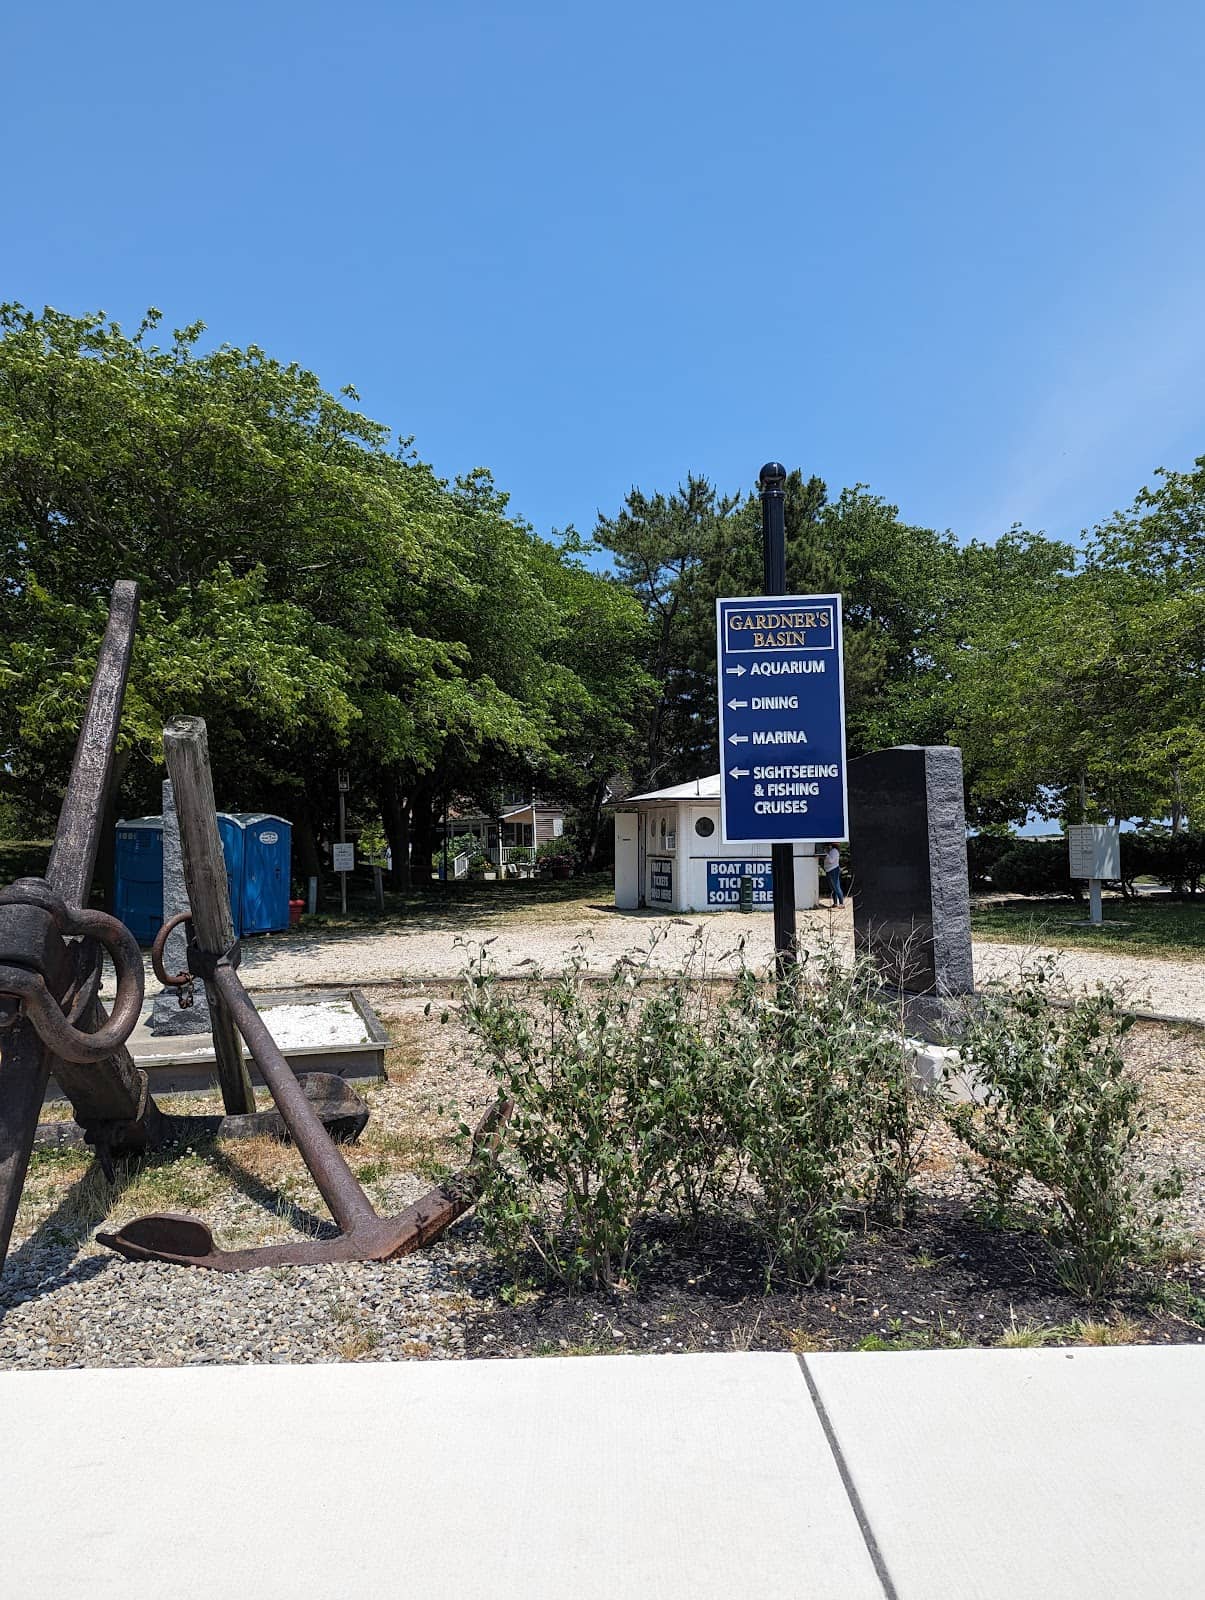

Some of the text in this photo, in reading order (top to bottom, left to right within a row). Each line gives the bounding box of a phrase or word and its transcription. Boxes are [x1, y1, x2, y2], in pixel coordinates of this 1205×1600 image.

[729, 612, 830, 630] GARDNER'S
[753, 631, 806, 647] BASIN
[750, 660, 826, 676] AQUARIUM
[751, 696, 799, 710] DINING
[752, 731, 808, 745] MARINA
[753, 764, 839, 779] SIGHTSEEING
[754, 783, 819, 797] & FISHING
[754, 800, 808, 814] CRUISES
[710, 863, 772, 875] BOAT RIDE
[718, 877, 765, 888] TICTS
[709, 890, 774, 902] SOLD ERE
